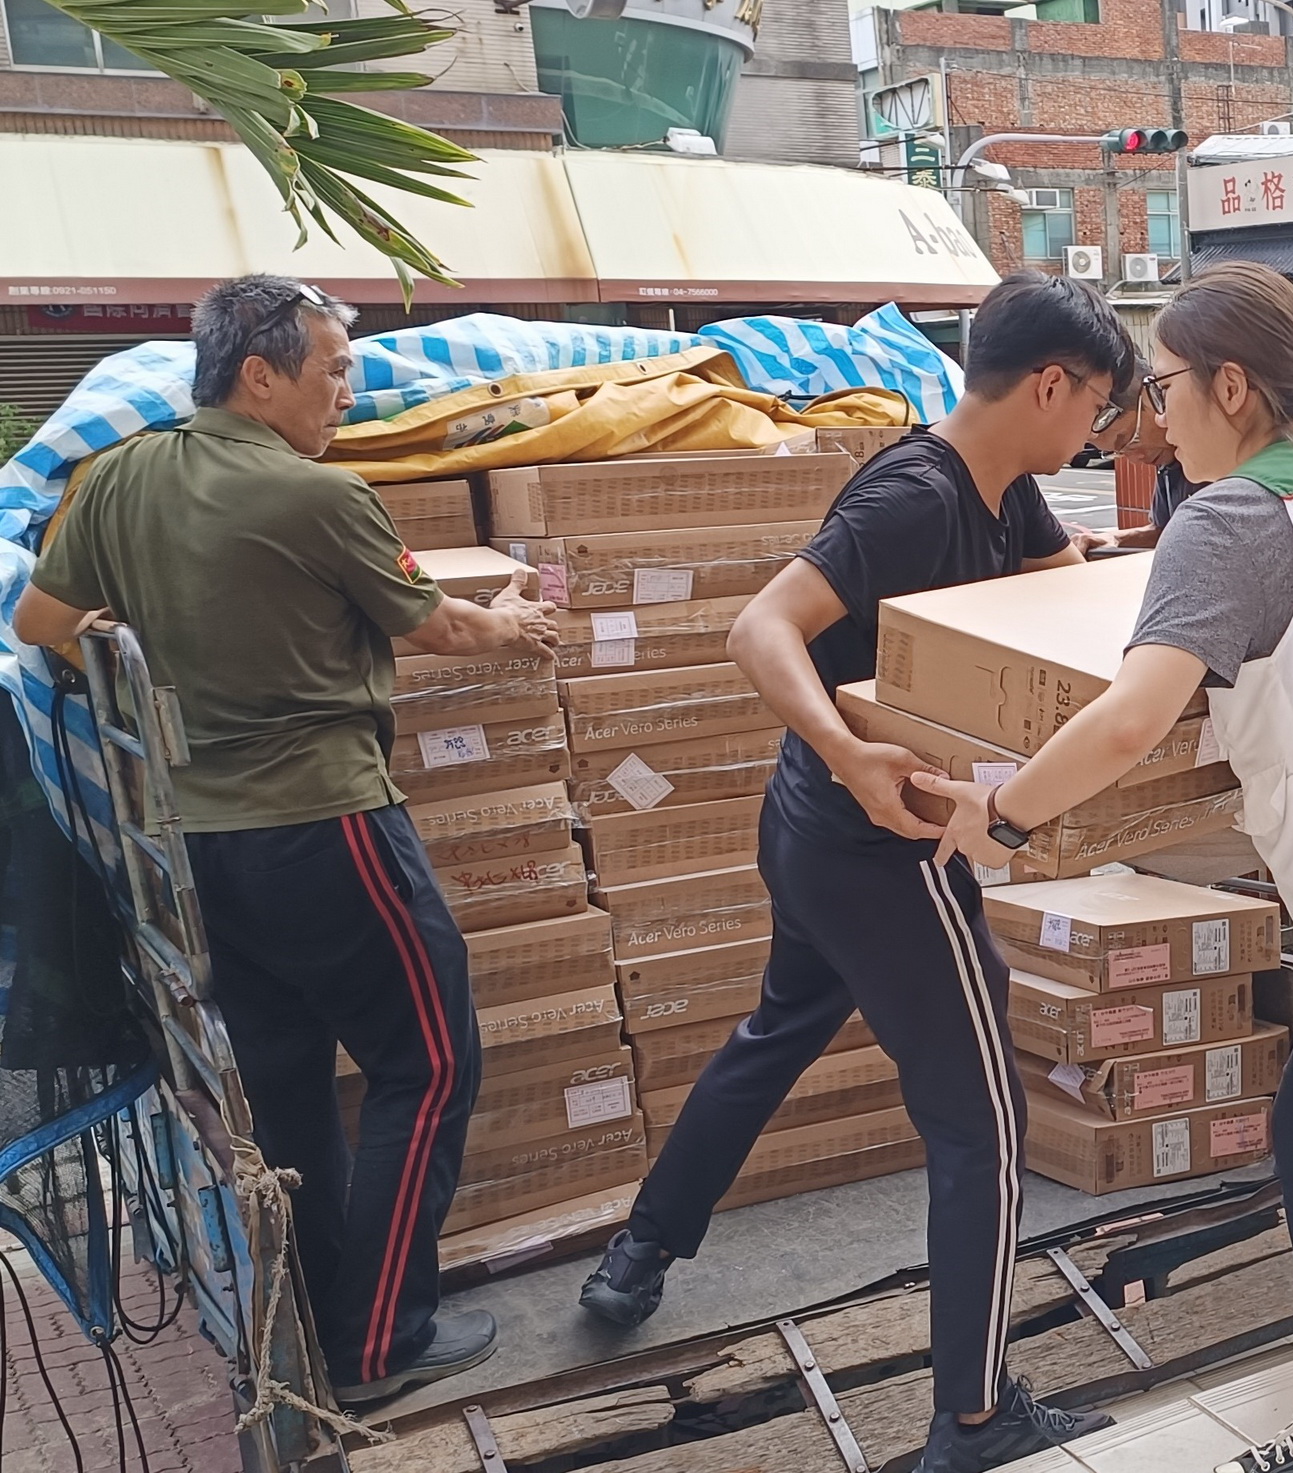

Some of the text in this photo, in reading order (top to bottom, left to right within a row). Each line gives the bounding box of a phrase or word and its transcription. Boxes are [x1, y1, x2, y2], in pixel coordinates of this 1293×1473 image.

[1220, 170, 1287, 216] 品格
[581, 580, 630, 596] acer
[411, 666, 464, 682] Series
[505, 656, 541, 671] Acer
[507, 725, 556, 746] acer
[584, 715, 699, 741] Acer Vero Series
[429, 796, 556, 826] Acer Vero Series
[1074, 815, 1195, 861] Acer Vero Series
[627, 918, 742, 947] Acer Vero Series
[1069, 930, 1094, 948] acer
[480, 999, 604, 1034] Acer Vero Series
[639, 999, 689, 1020] acer
[1039, 1001, 1062, 1020] acer
[570, 1061, 622, 1085] acer
[511, 1128, 633, 1166] Acer Vero Series
